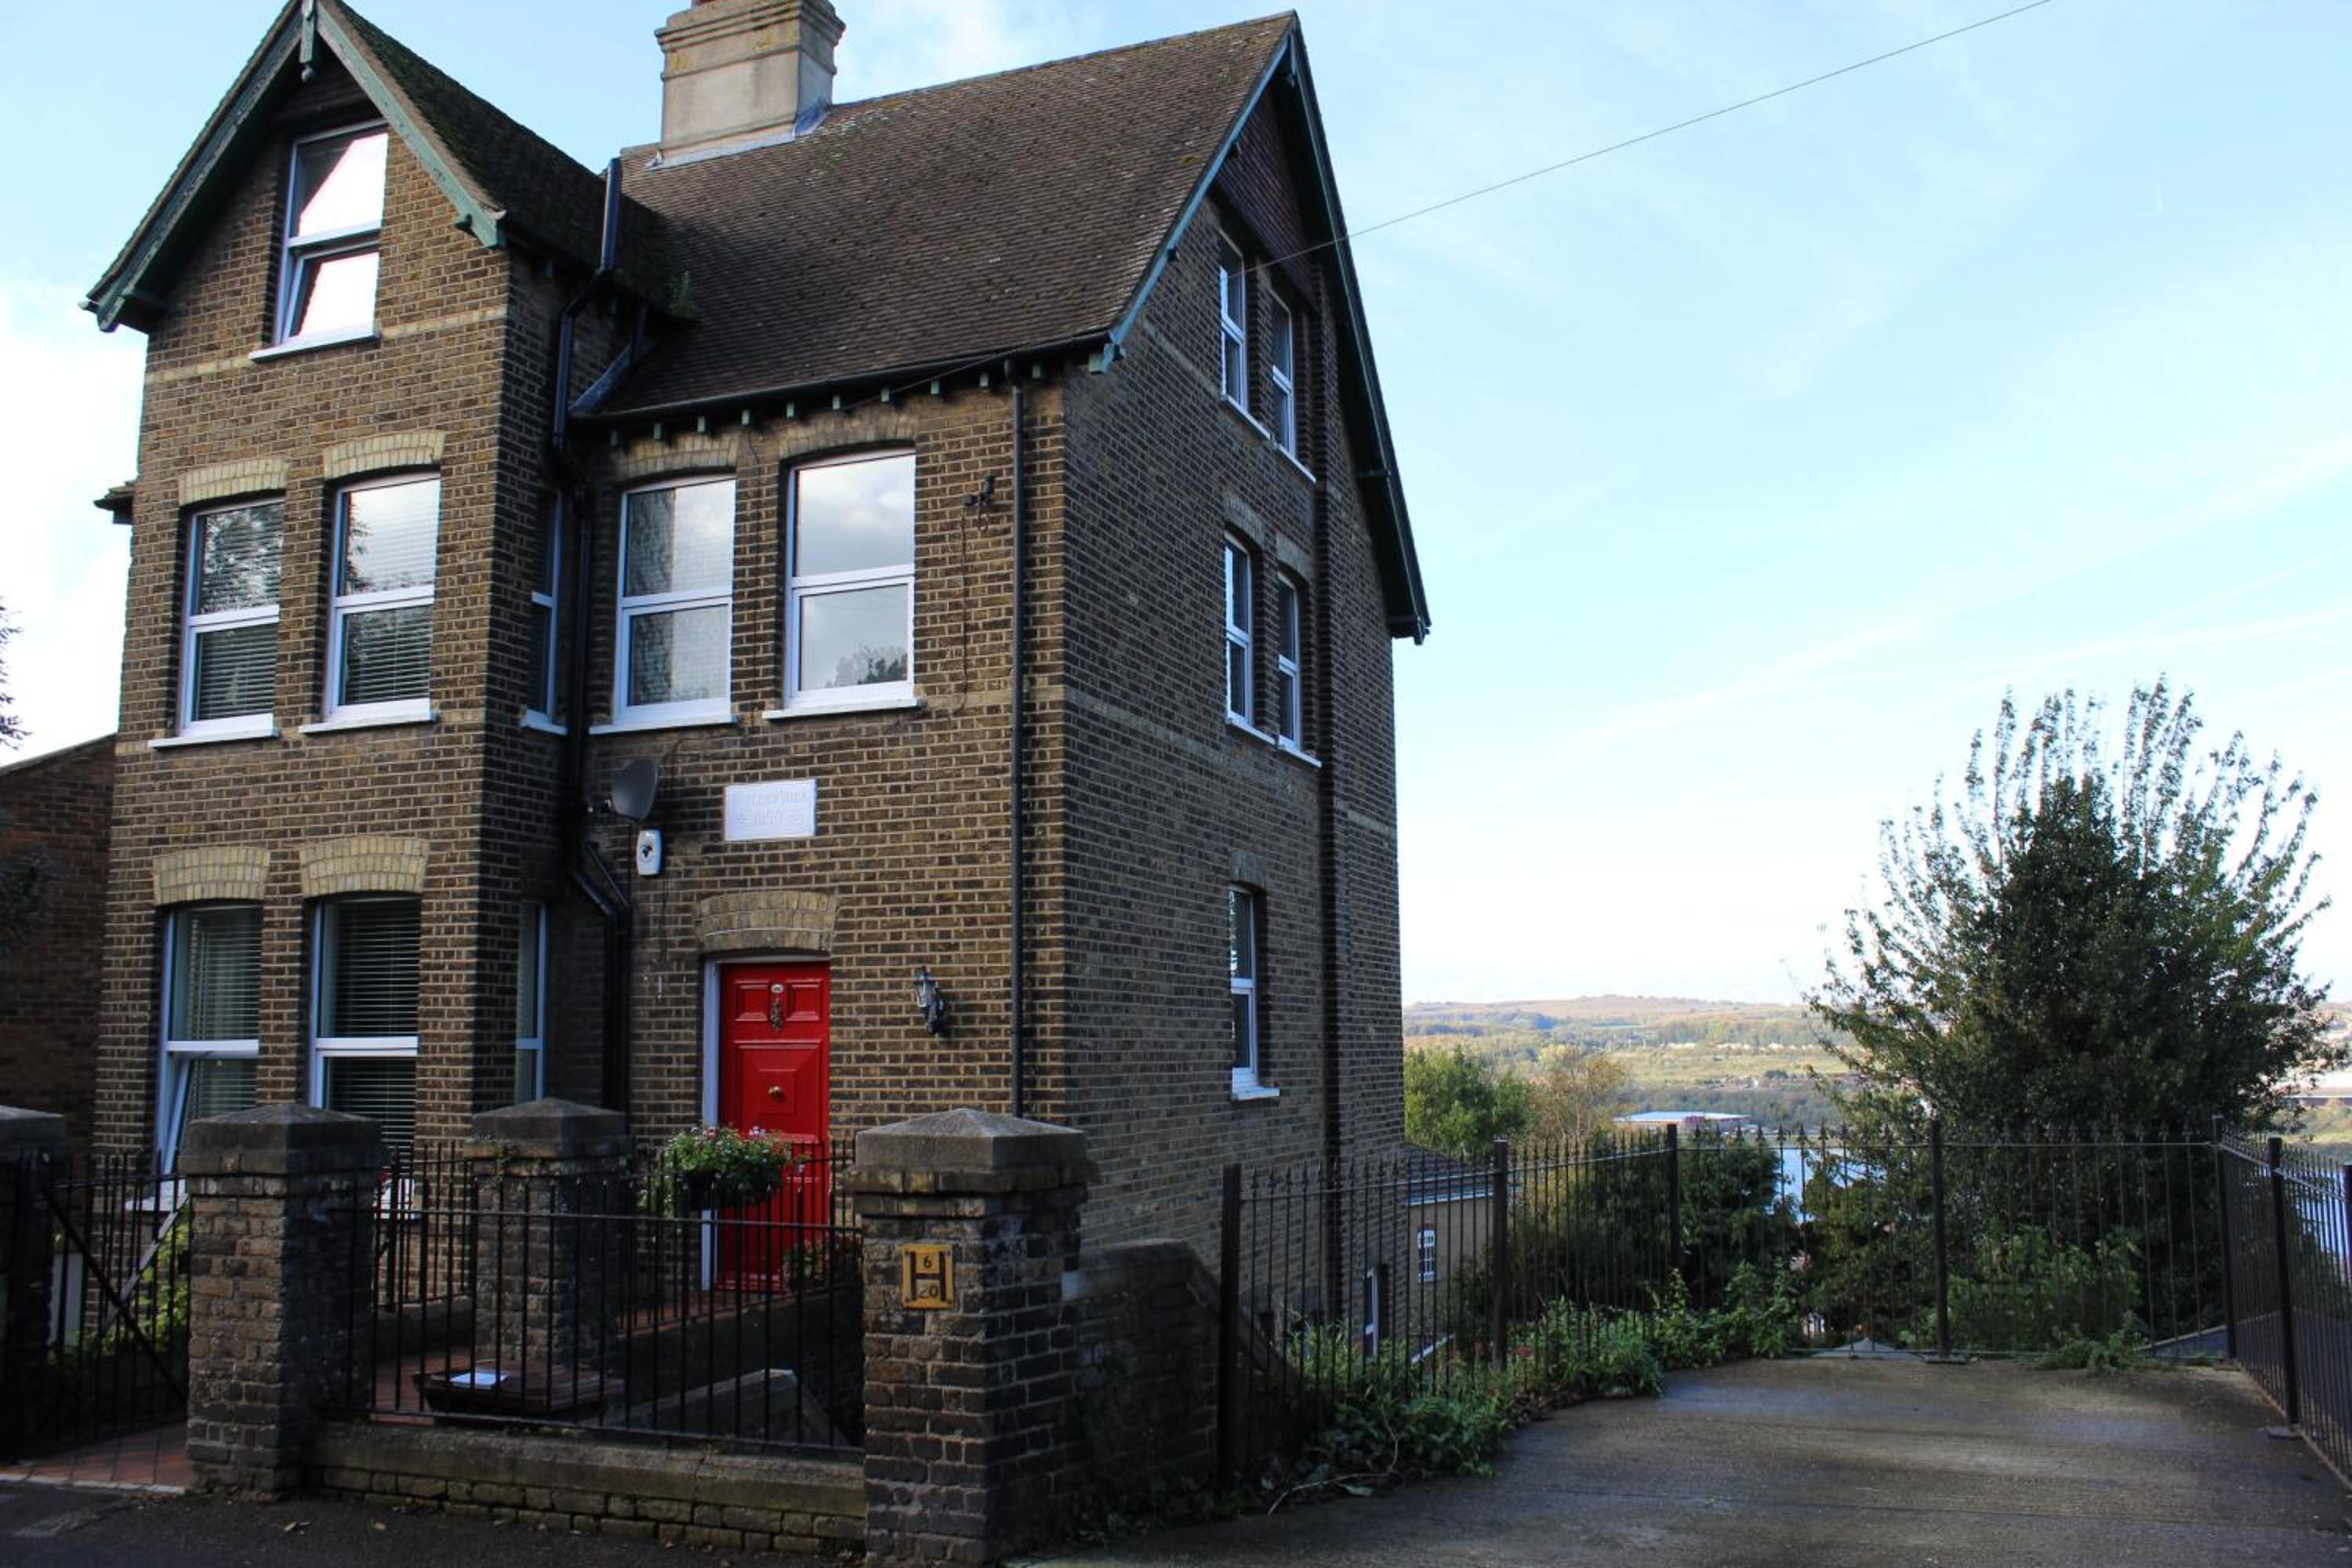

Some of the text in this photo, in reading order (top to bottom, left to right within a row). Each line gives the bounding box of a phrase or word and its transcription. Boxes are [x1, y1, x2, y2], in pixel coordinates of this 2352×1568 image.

[924, 1255, 932, 1268] 6
[910, 1250, 946, 1301] H
[918, 1284, 938, 1298] 20
